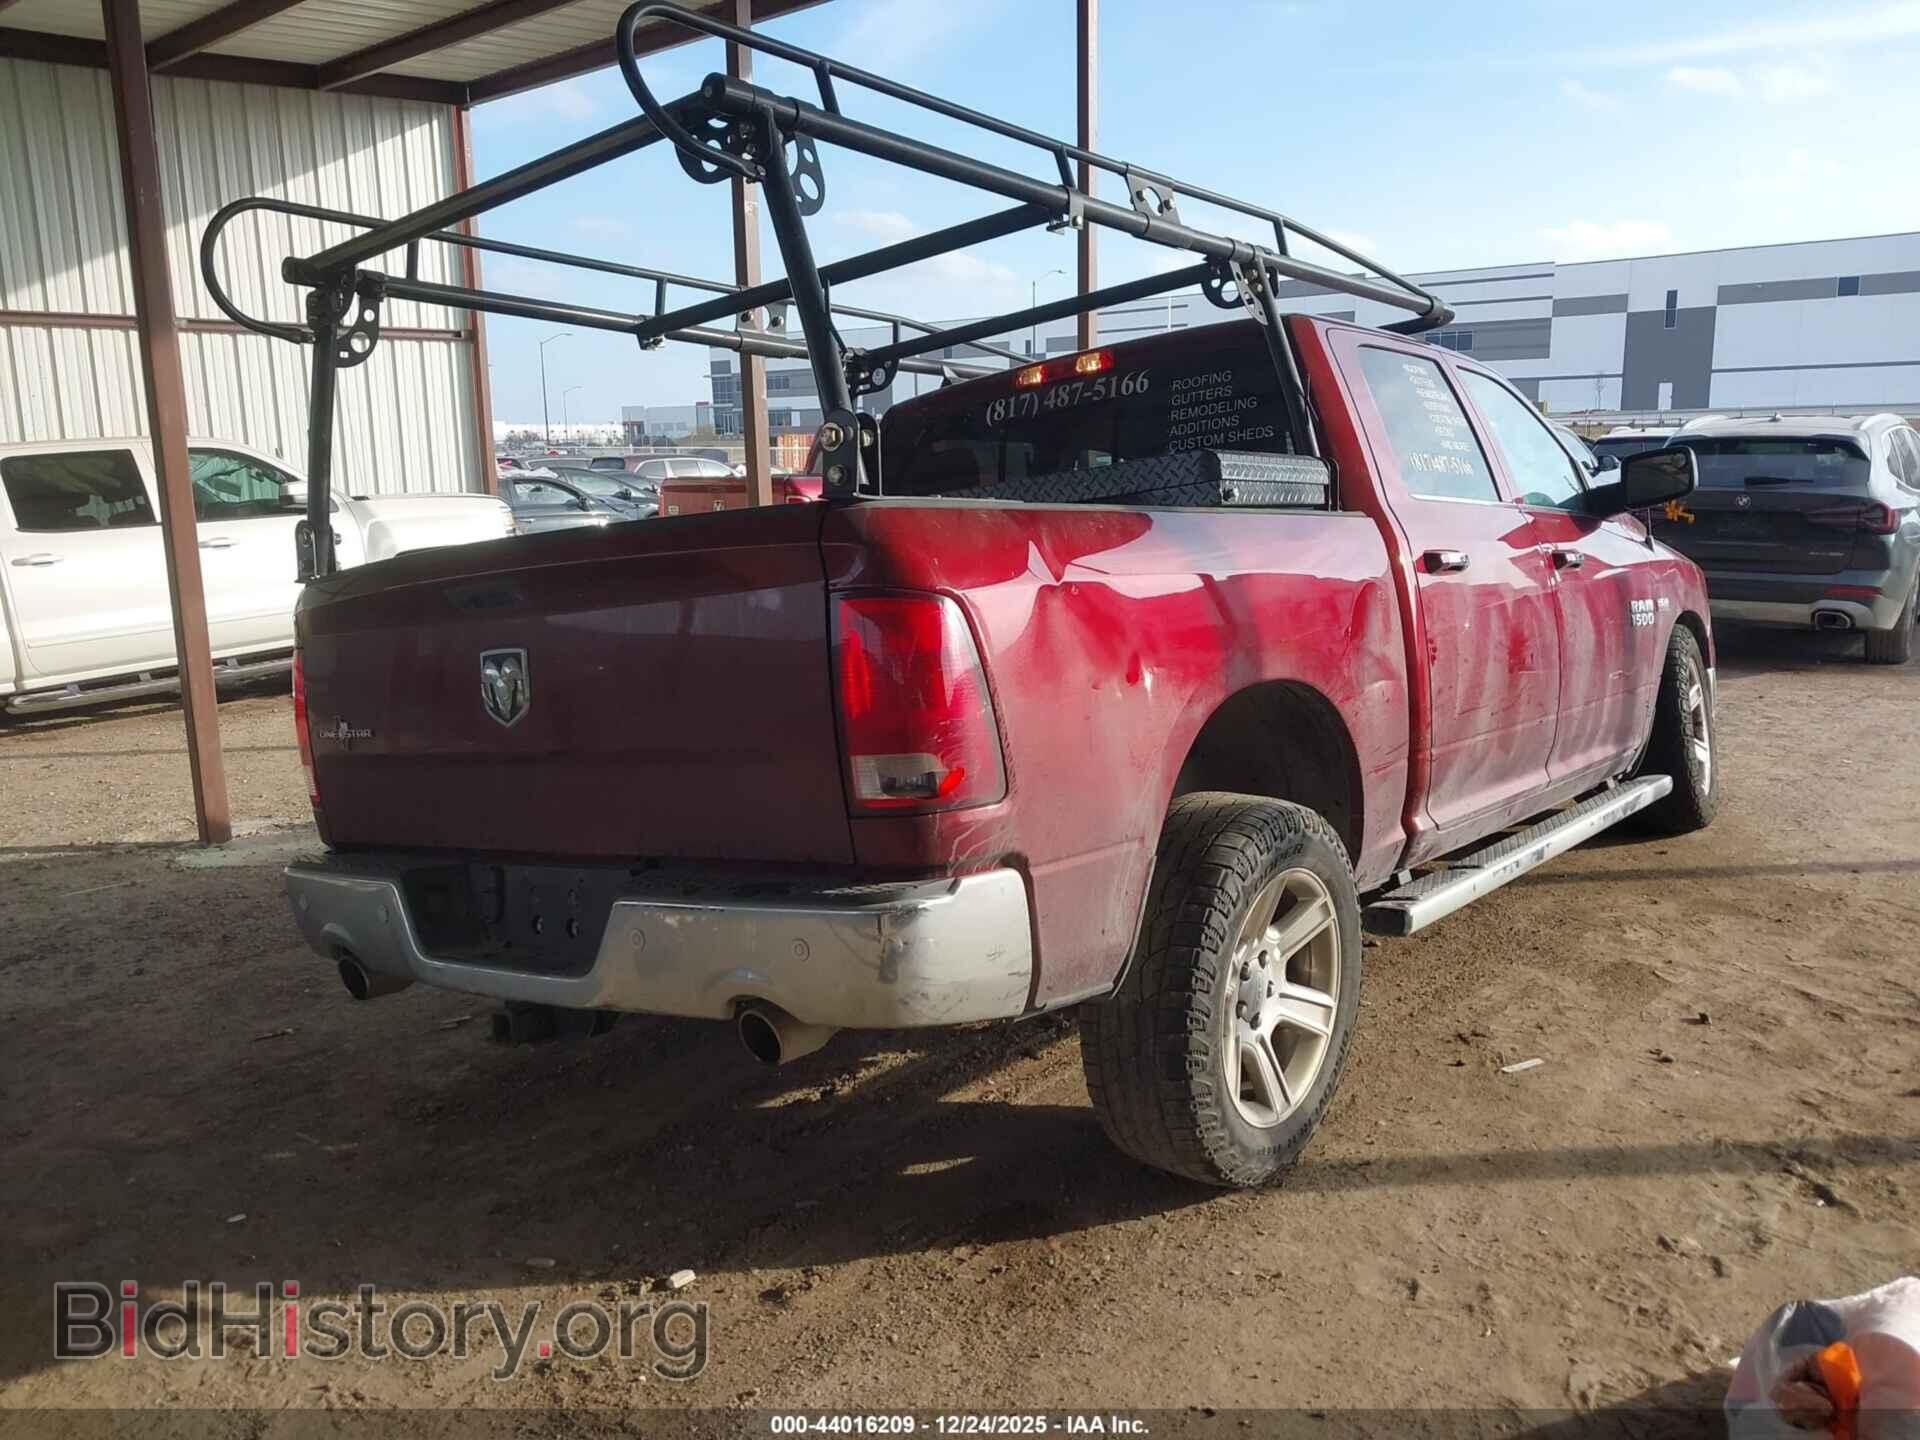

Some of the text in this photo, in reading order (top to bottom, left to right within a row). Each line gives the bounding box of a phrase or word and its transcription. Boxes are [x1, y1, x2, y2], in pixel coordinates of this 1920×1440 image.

[1171, 370, 1233, 391] ROOFING
[985, 369, 1150, 427] (817) 487-5166
[1171, 385, 1233, 406] GUTTERS
[1170, 396, 1257, 421] REMODELING
[1169, 415, 1240, 437] ADDITIONS
[1168, 425, 1274, 451] CUSTOM SHEDS
[1630, 599, 1654, 613] RAM
[1631, 611, 1655, 627] 1500
